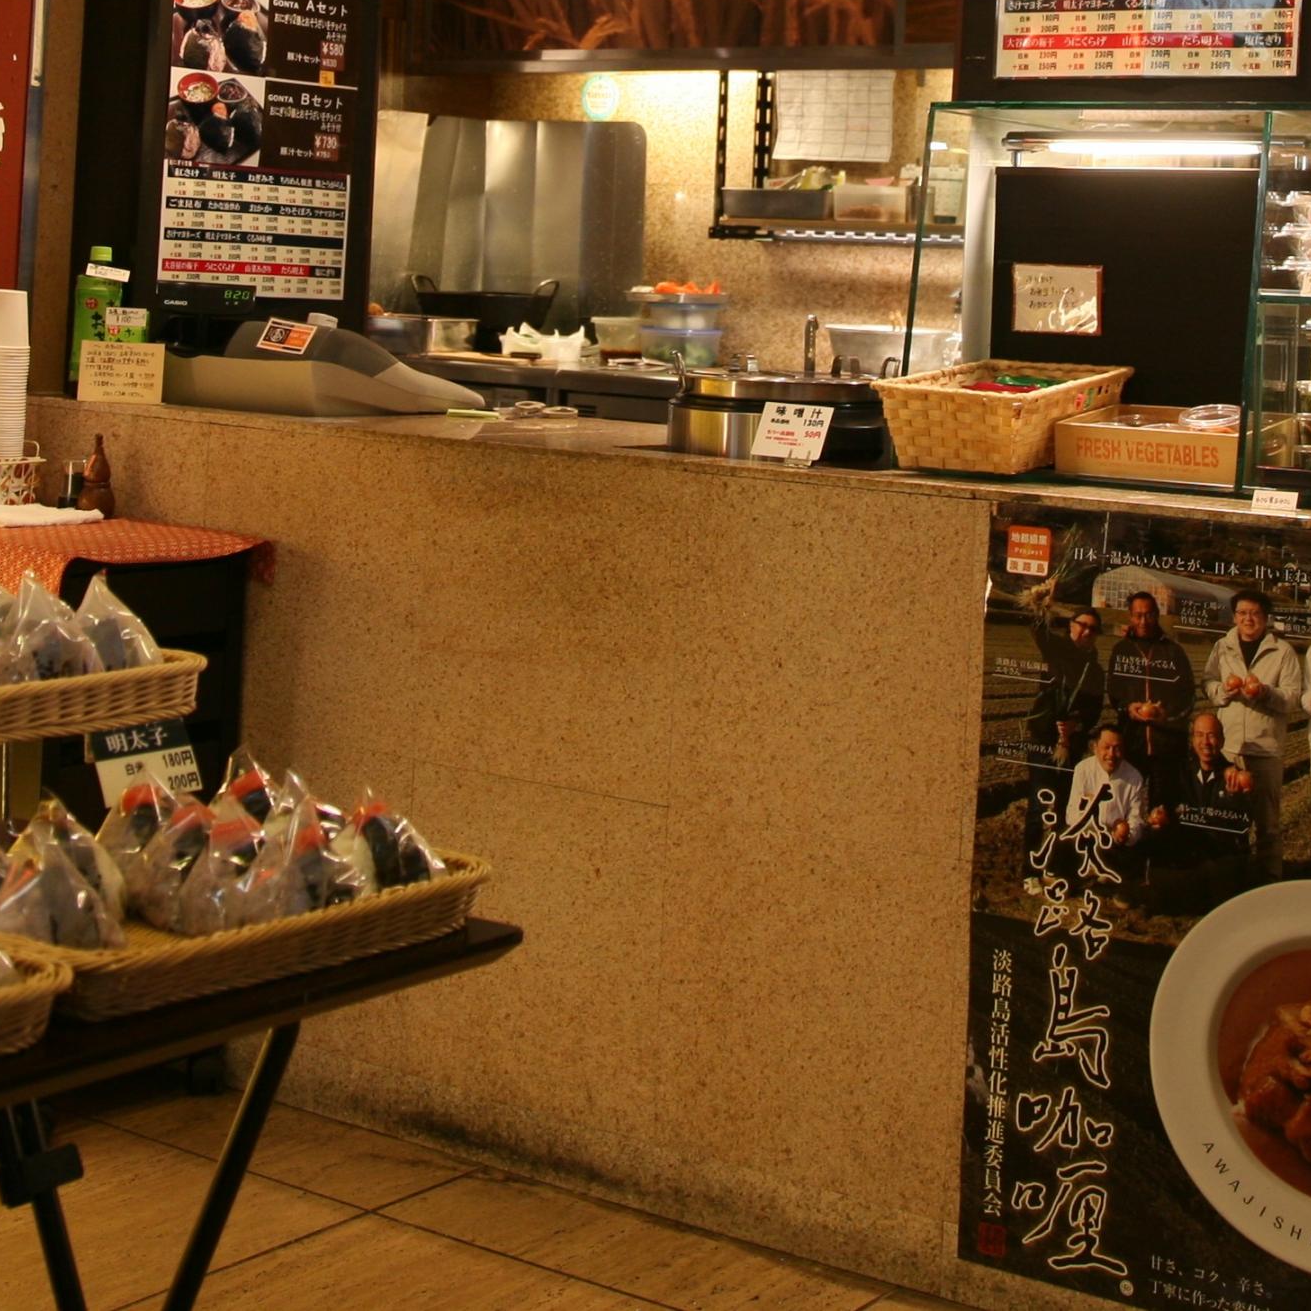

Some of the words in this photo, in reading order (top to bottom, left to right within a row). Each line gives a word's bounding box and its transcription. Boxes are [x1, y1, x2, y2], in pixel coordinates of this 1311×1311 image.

[267, 93, 294, 104] GONTA
[300, 93, 344, 110] Bセット
[1076, 437, 1121, 461] FRESH
[1126, 441, 1219, 468] VEGETABLES
[105, 727, 168, 753] 明太子
[162, 750, 194, 768] 180円
[168, 771, 200, 790] 200円
[983, 948, 1013, 1217] 淡路島活性化推進委員会
